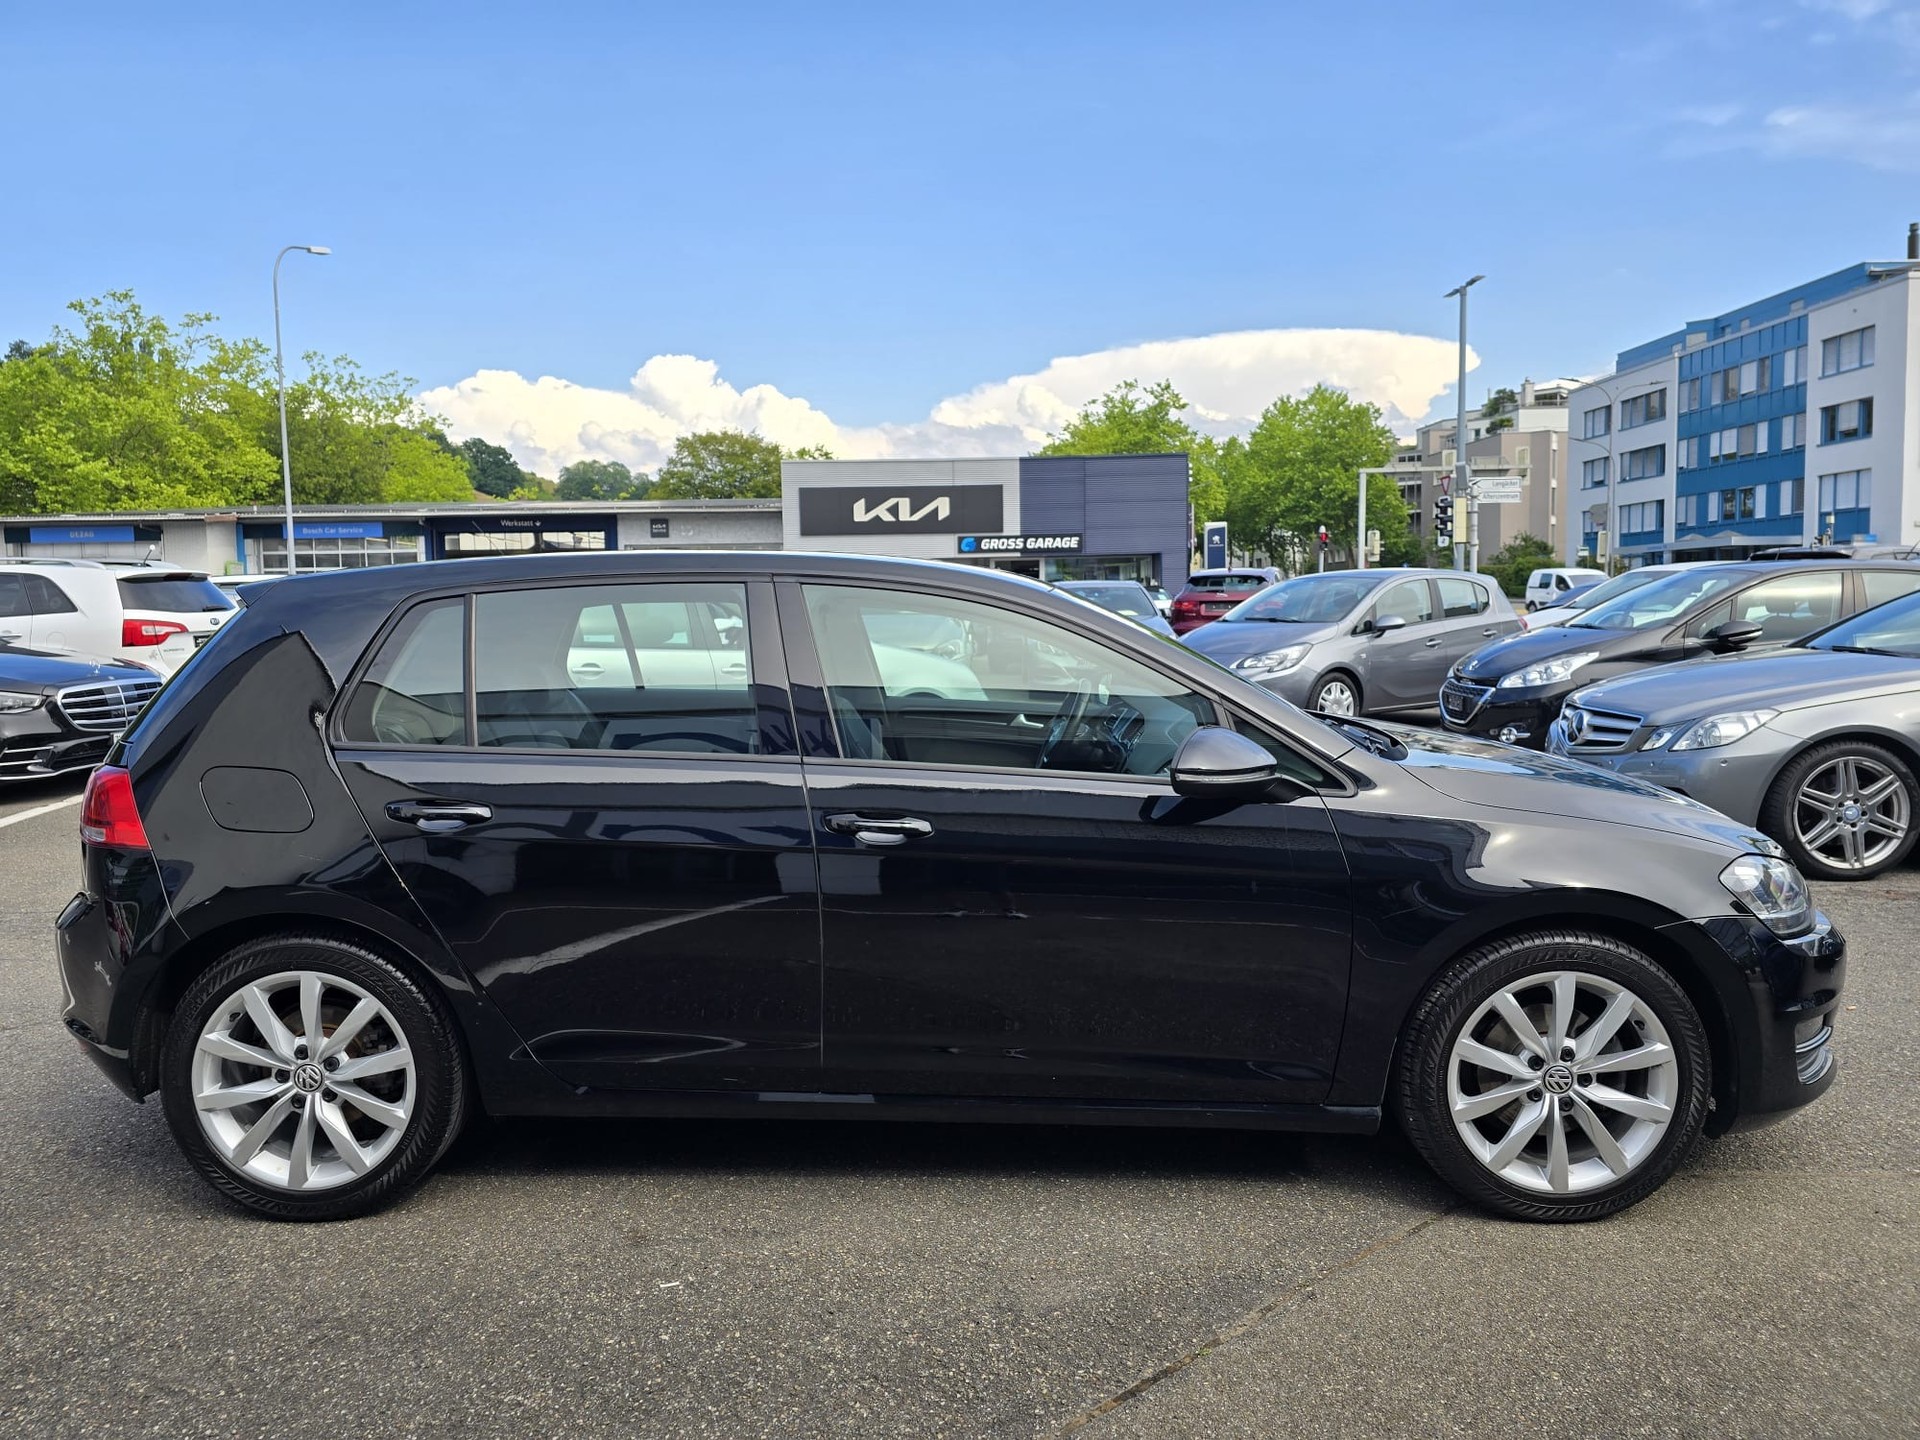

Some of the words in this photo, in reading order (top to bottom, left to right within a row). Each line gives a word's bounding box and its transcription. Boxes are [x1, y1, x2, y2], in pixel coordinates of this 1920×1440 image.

[853, 496, 951, 522] KIA
[500, 519, 534, 527] Werkstatt
[302, 527, 323, 535] Bosch
[338, 526, 364, 534] Service
[980, 537, 1024, 550] GROSS
[1026, 536, 1080, 549] GARAGE
